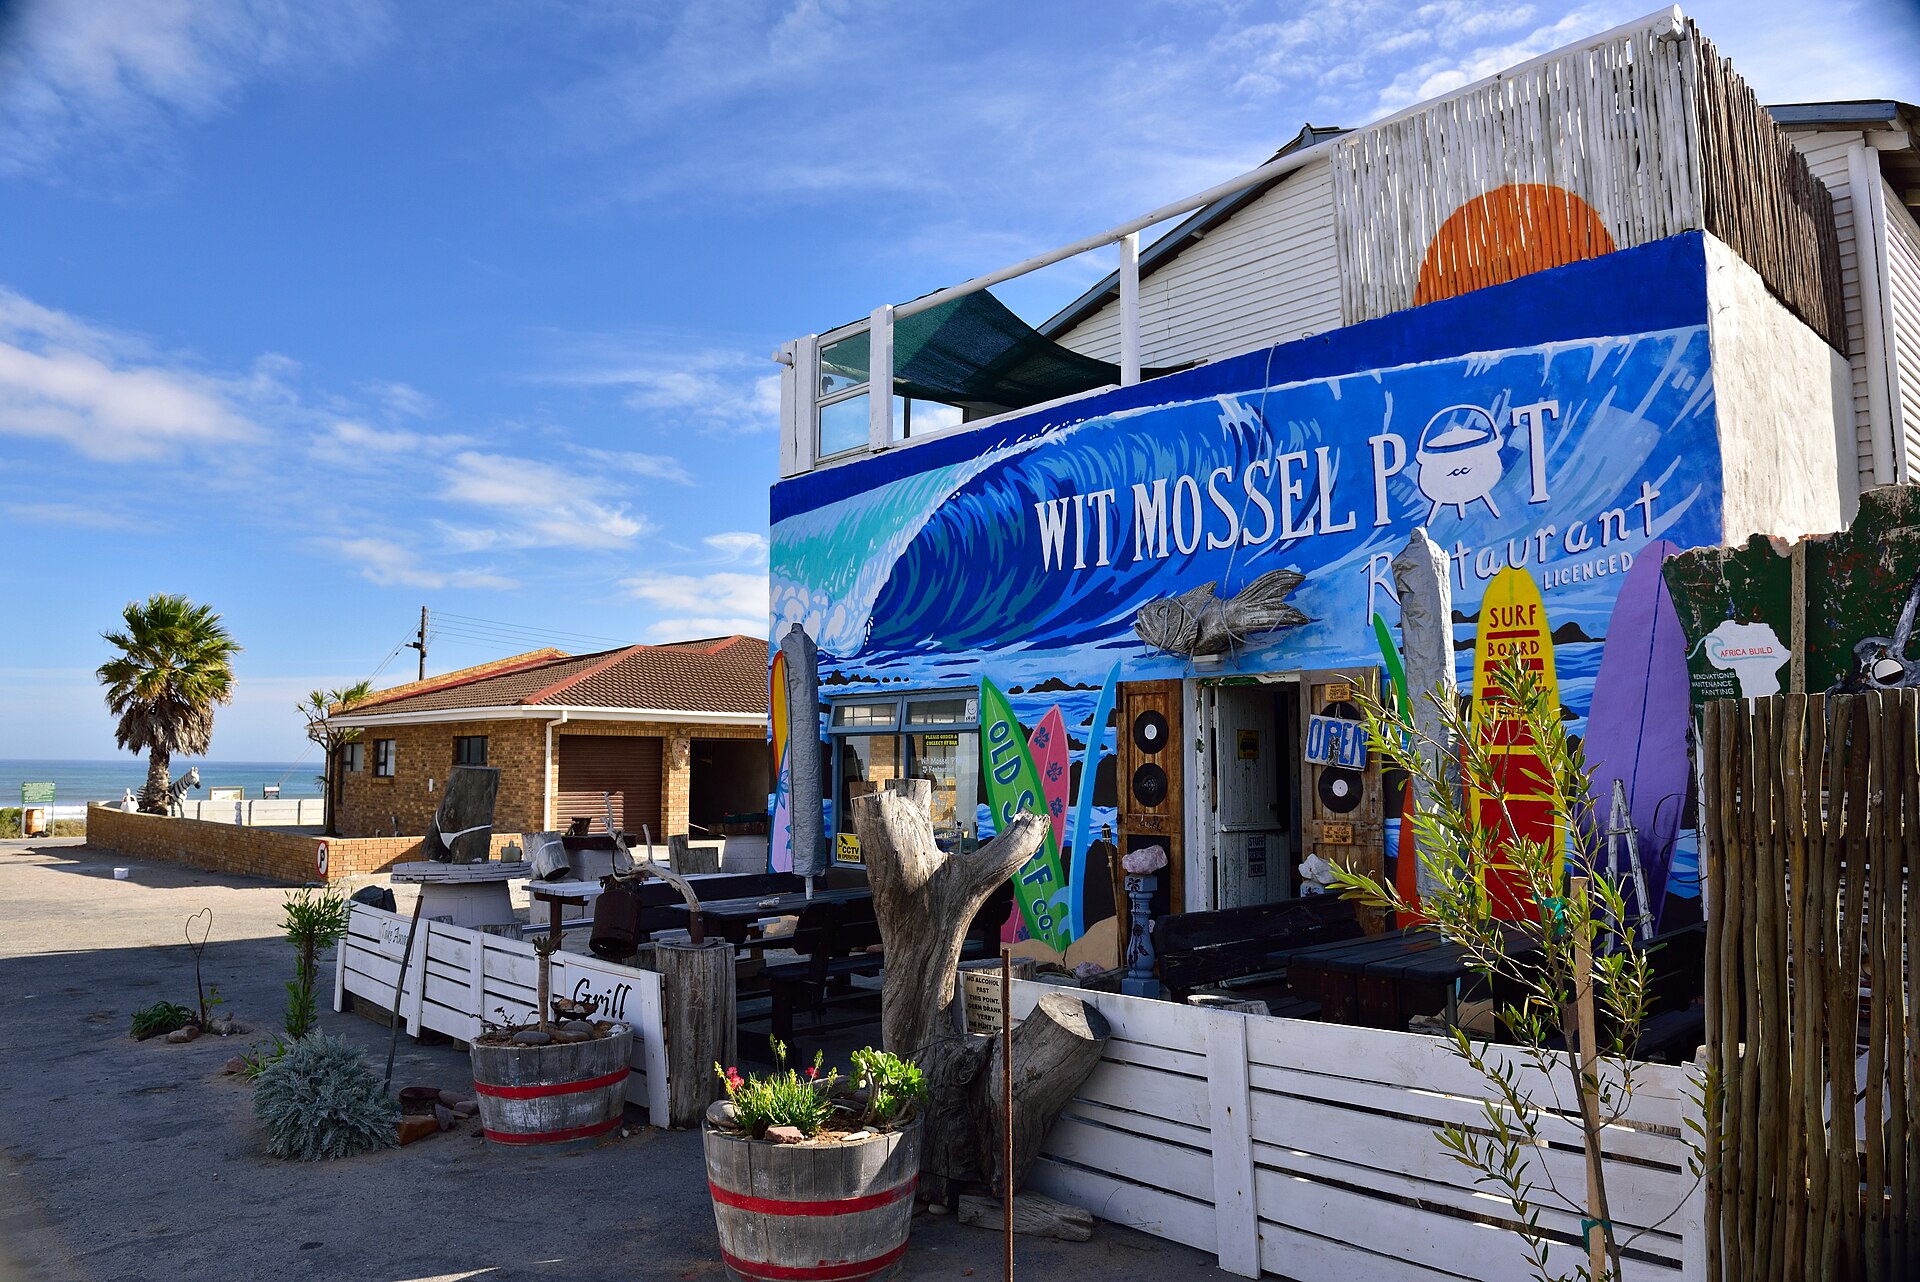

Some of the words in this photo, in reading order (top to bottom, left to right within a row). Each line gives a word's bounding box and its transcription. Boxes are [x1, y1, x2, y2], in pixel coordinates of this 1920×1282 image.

[1034, 488, 1115, 573] WIT
[1131, 446, 1357, 562] MOSSEL
[1359, 480, 1661, 627] Rtaurant
[1543, 550, 1634, 591] LICENCED
[1489, 603, 1537, 629] SURF
[1720, 648, 1747, 657] AFRICA
[1748, 646, 1773, 656] BUILD
[1692, 671, 1736, 680] RENOVATIONS
[1701, 687, 1735, 696] PAINTING
[988, 719, 1022, 786] OLD
[1308, 718, 1369, 767] OPEN
[842, 846, 860, 855] CCTV
[1002, 789, 1054, 887] SF
[1031, 898, 1054, 942] CO.
[969, 994, 982, 1002] THIS
[976, 977, 999, 986] ALCOHOL
[572, 977, 633, 1020] Grill
[982, 1005, 1002, 1014] DRANK
